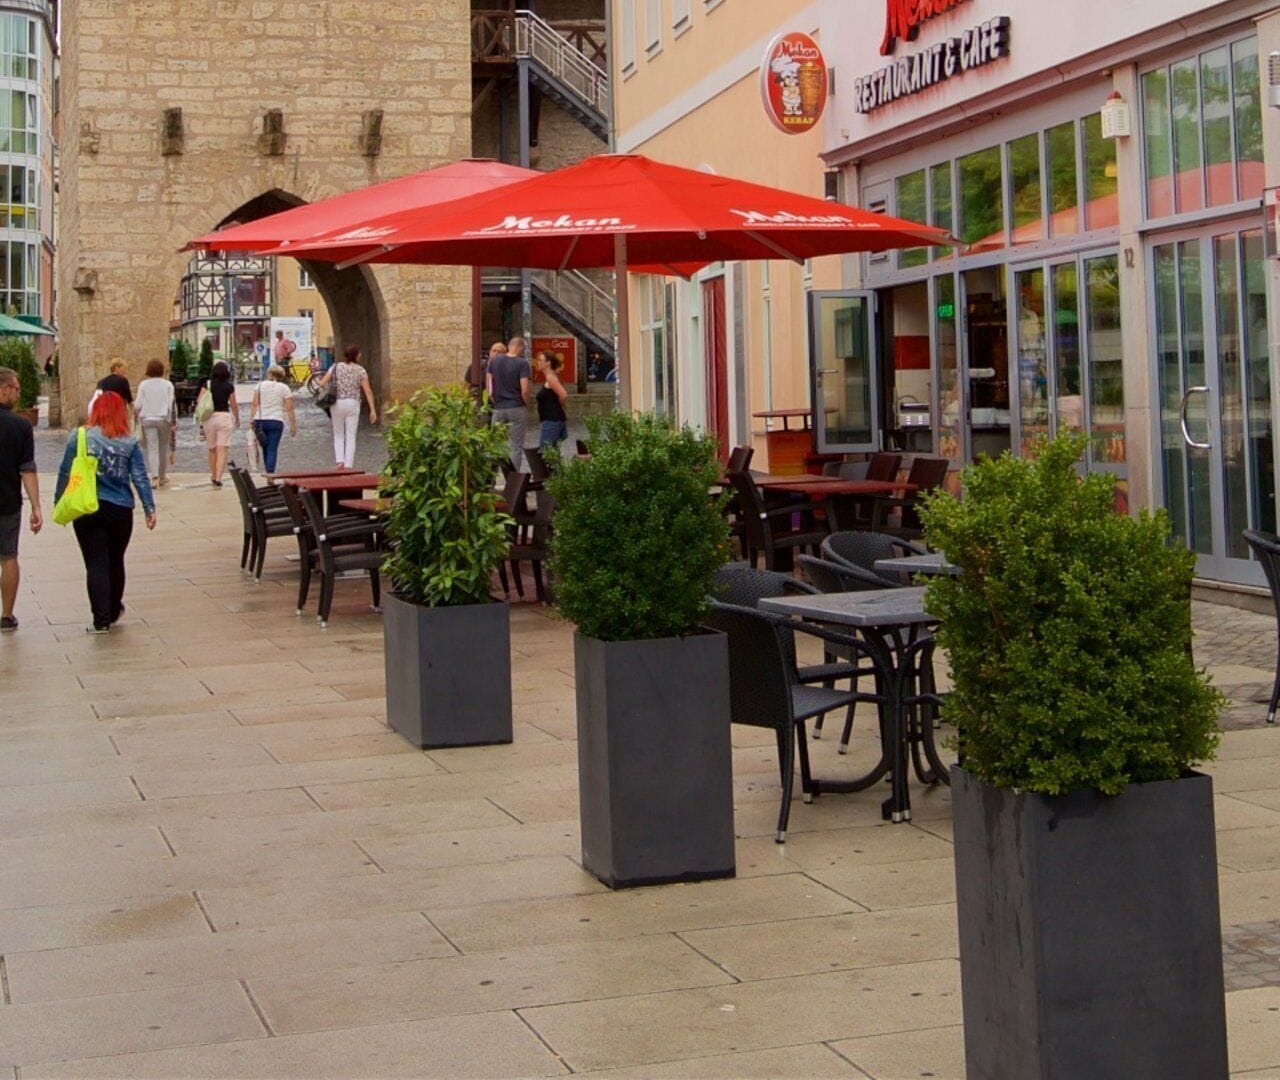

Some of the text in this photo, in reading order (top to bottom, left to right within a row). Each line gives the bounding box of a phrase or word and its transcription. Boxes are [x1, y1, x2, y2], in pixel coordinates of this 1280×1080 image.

[778, 40, 820, 59] Mekan
[854, 16, 1011, 114] RESTAURANT & CAFE
